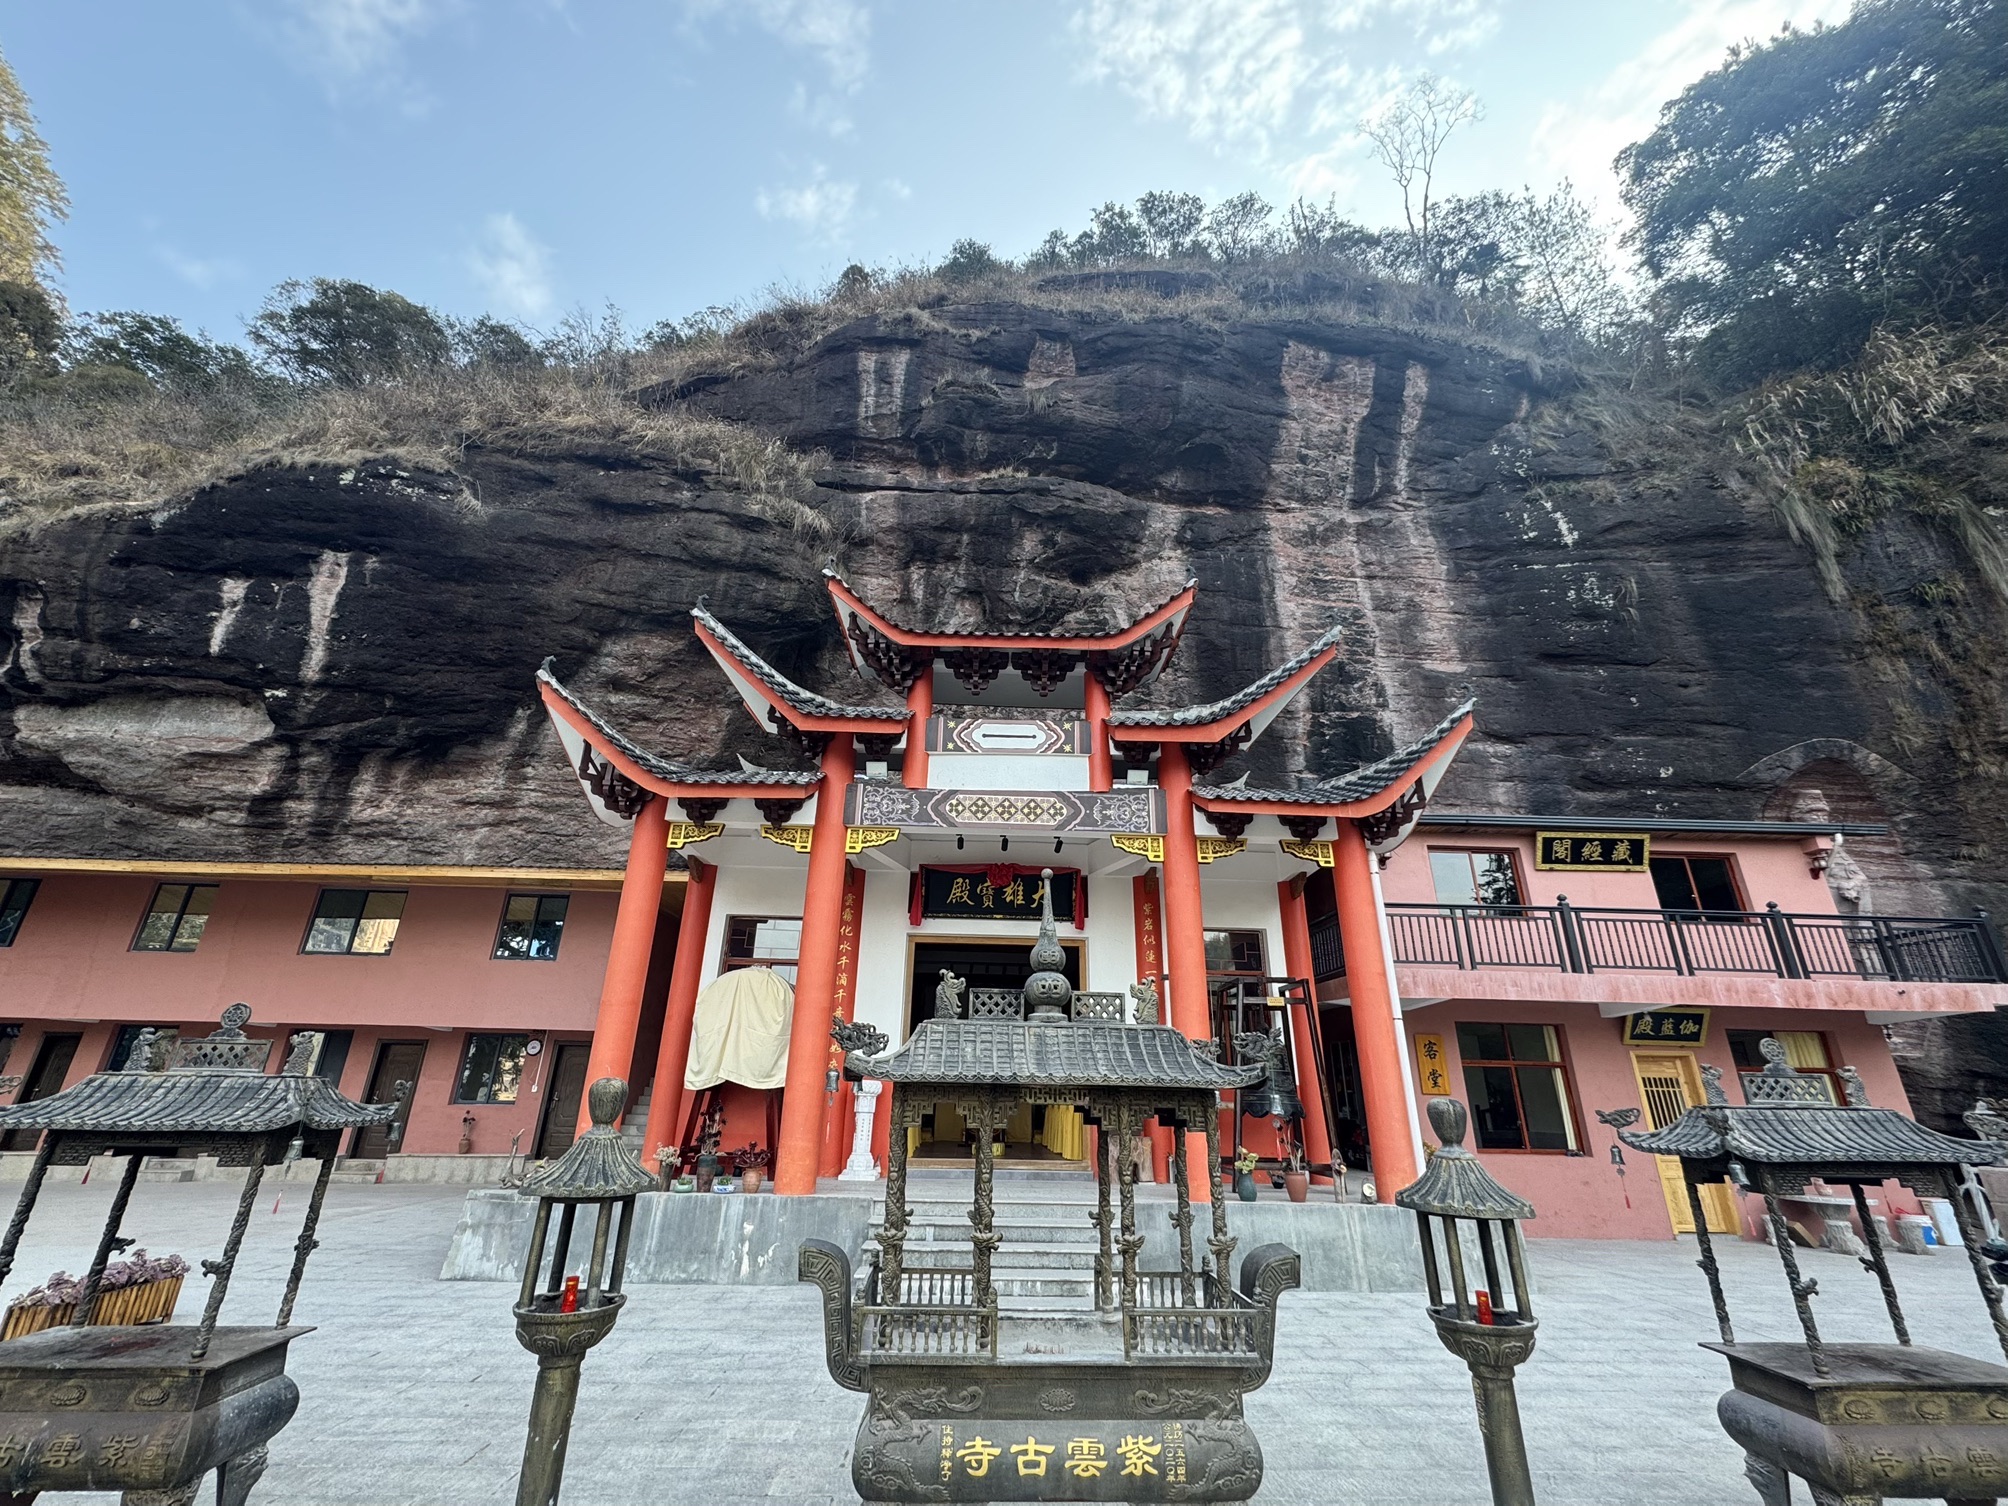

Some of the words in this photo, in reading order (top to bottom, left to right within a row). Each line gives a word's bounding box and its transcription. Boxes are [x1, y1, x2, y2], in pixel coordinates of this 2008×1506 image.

[1552, 839, 1634, 864] 藏經閣
[1423, 1040, 1442, 1088] 客堂
[956, 1435, 1162, 1478] 紫雲古寺
